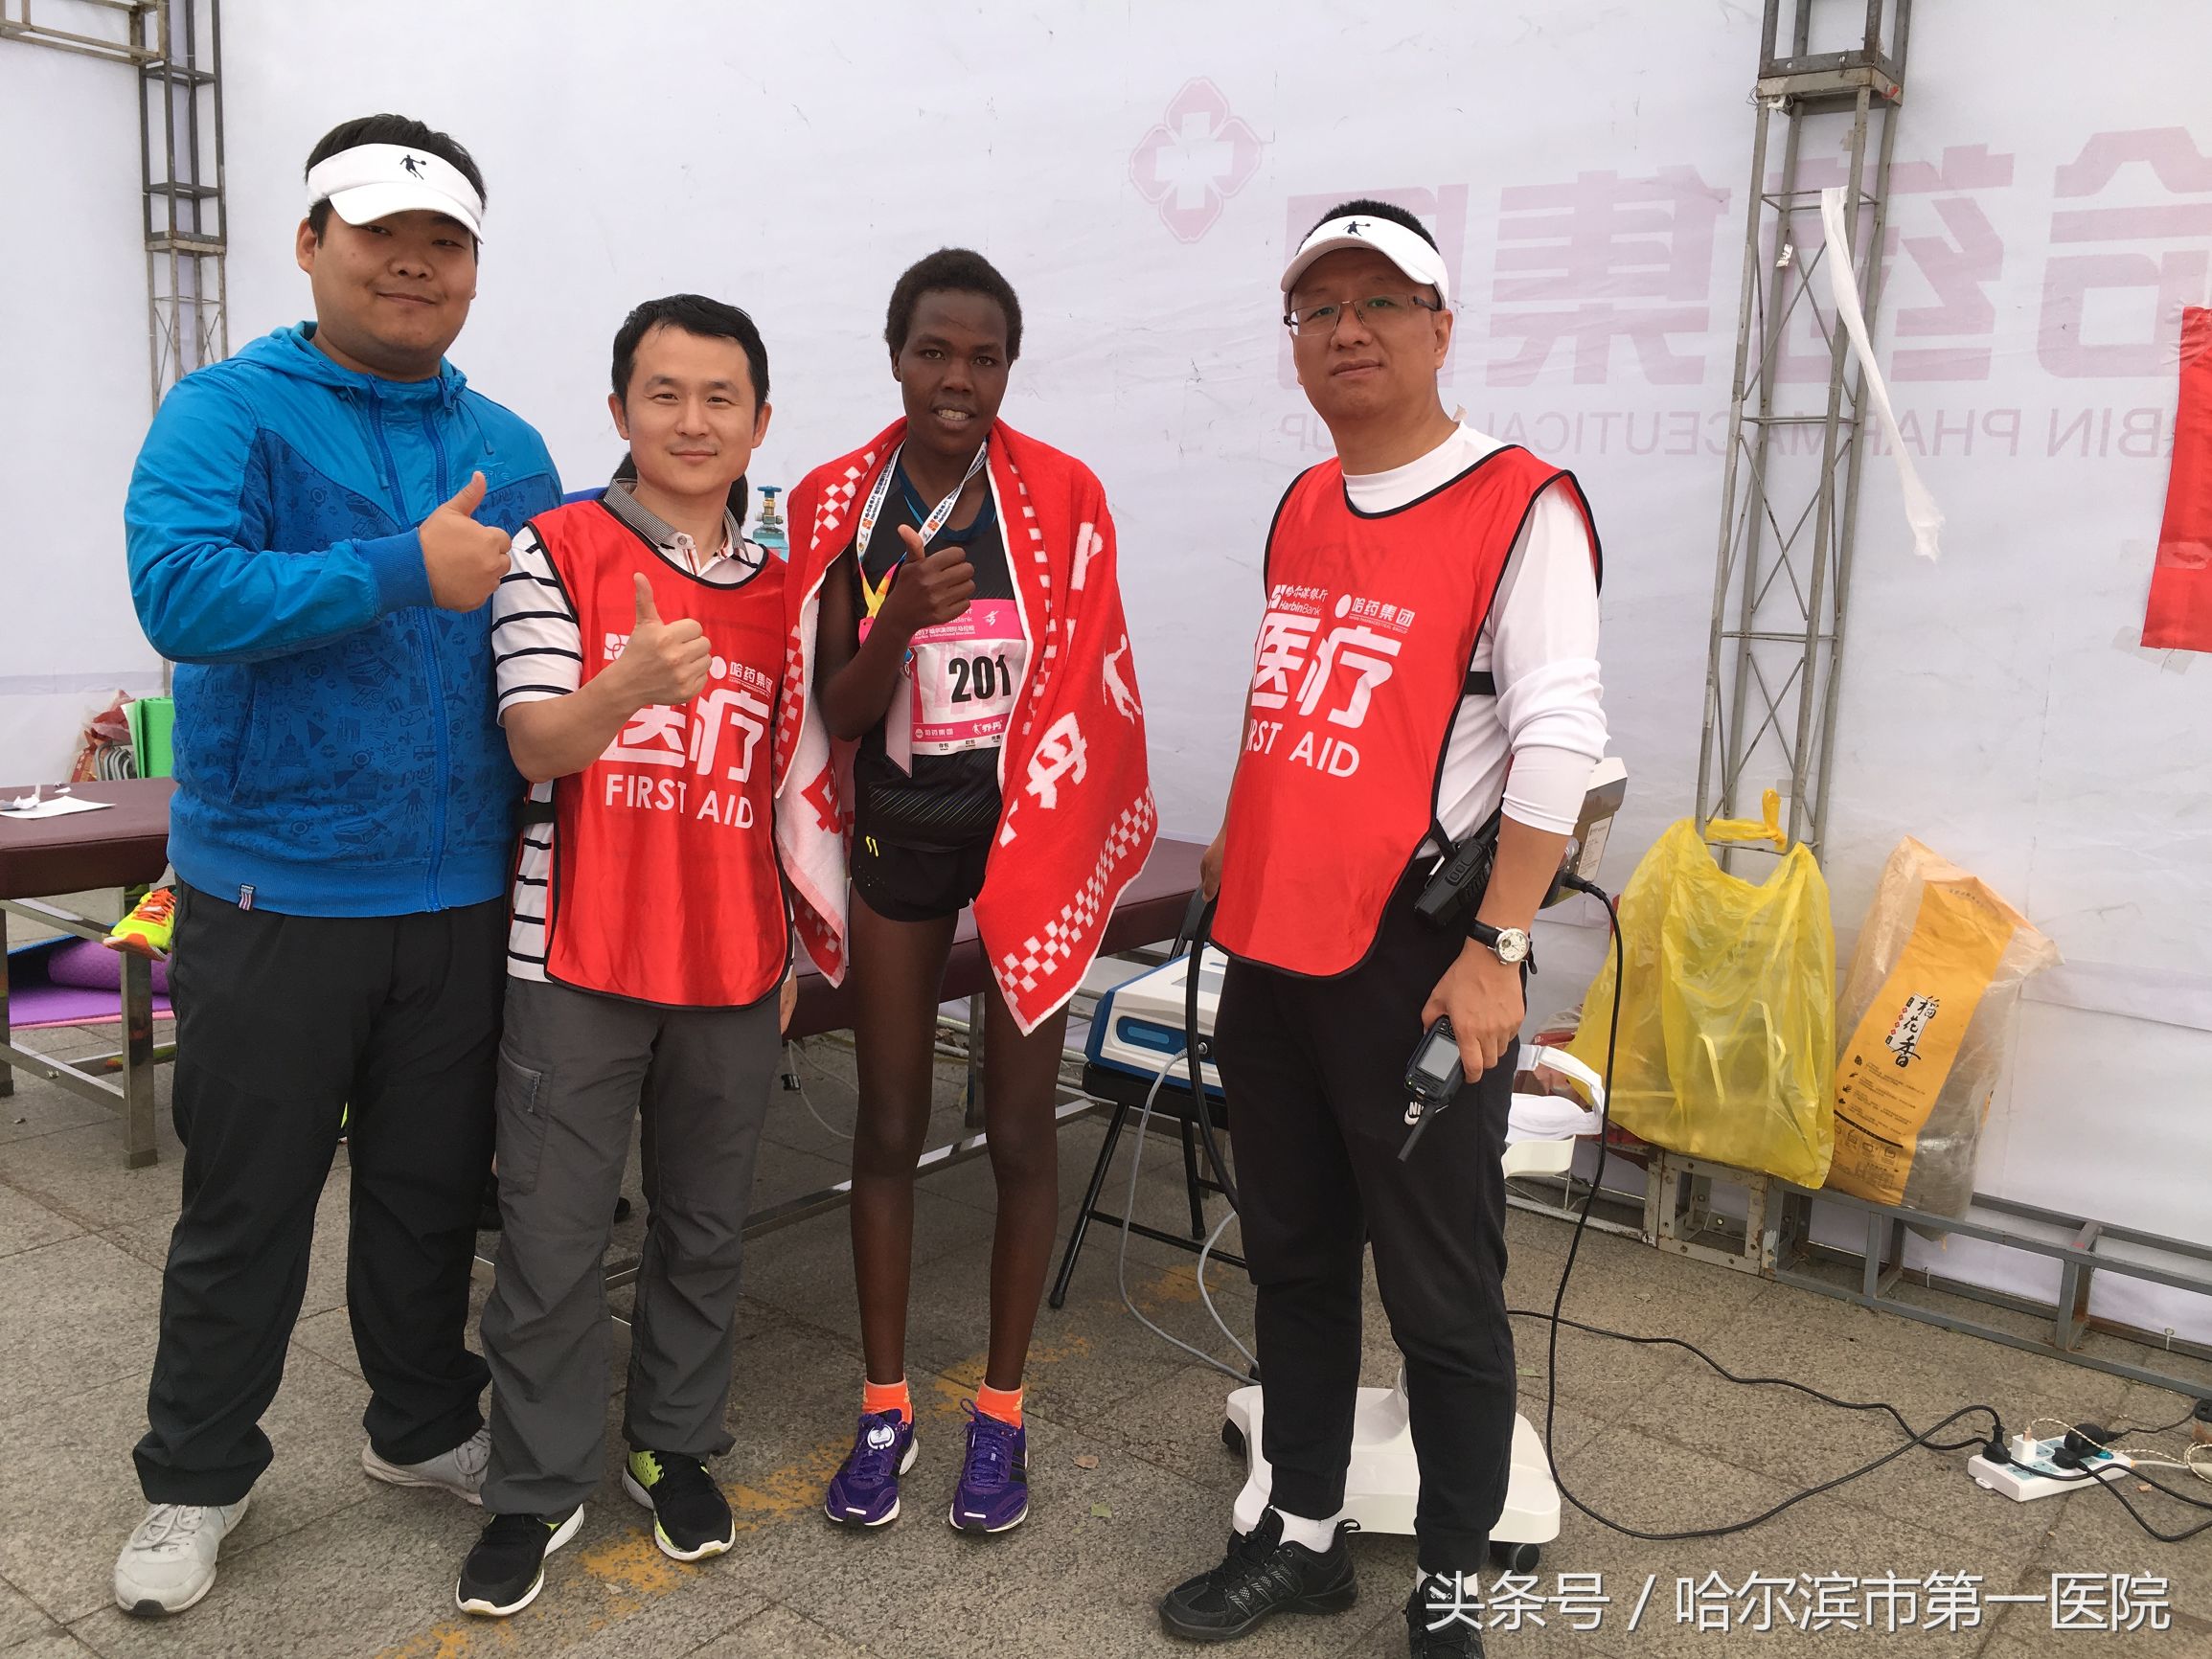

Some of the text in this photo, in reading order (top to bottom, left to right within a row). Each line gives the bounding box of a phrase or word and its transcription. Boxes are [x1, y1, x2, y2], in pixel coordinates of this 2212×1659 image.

[1279, 600, 1323, 616] HarbinBank
[1352, 598, 1415, 627] 哈药集团
[730, 661, 773, 693] 哈药集团
[948, 654, 1011, 703] 201
[1251, 612, 1402, 729] 医疗
[1288, 731, 1360, 778] AID
[605, 773, 754, 829] FIRST AID
[1891, 996, 1940, 1067] 稻花香
